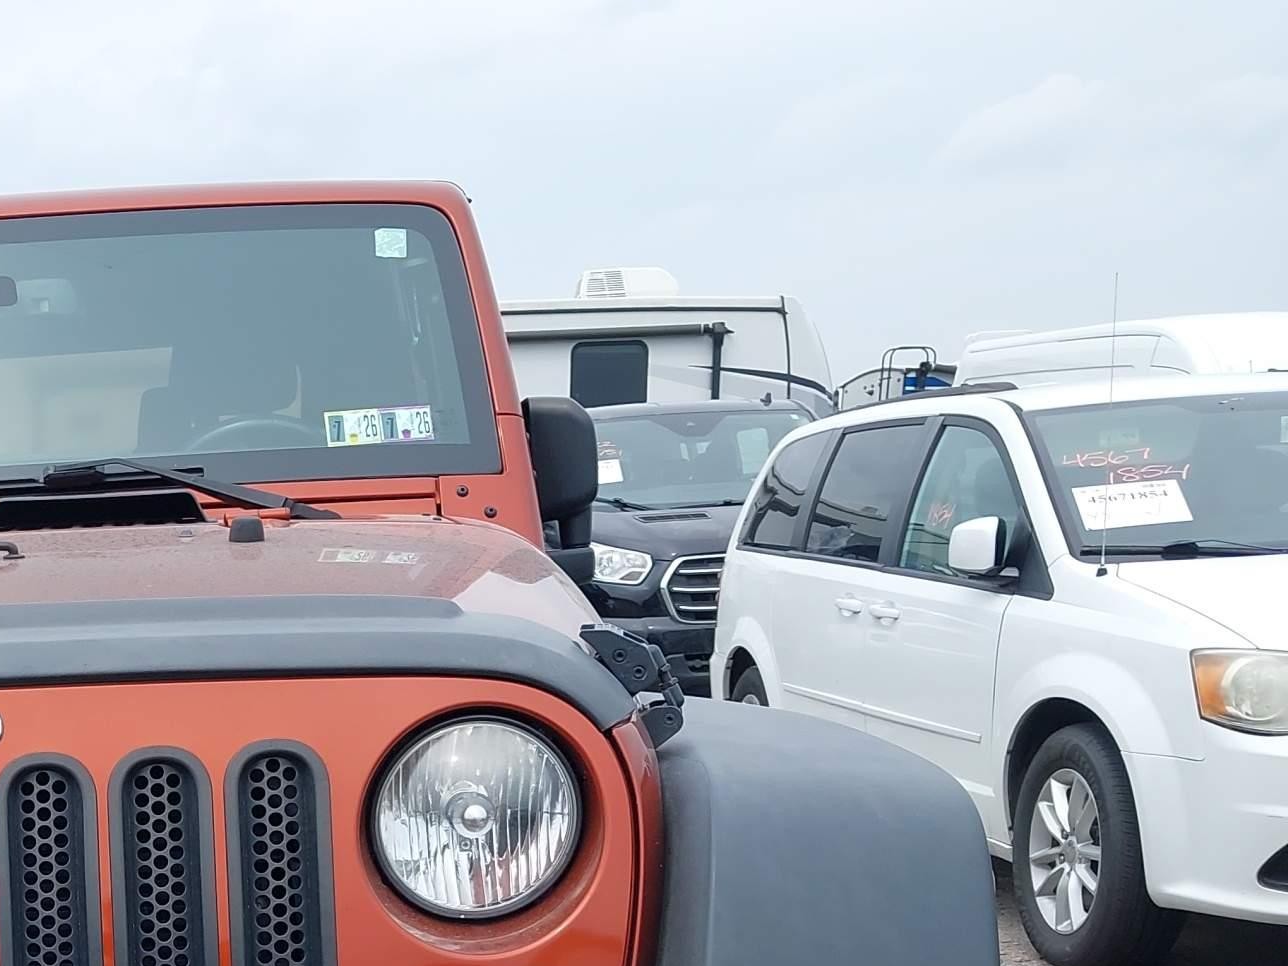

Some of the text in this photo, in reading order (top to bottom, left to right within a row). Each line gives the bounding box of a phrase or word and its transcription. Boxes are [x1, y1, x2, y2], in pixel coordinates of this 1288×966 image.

[363, 414, 378, 437] 26
[415, 411, 431, 434] 26
[1062, 447, 1150, 468] 4567
[1109, 464, 1190, 485] 1854
